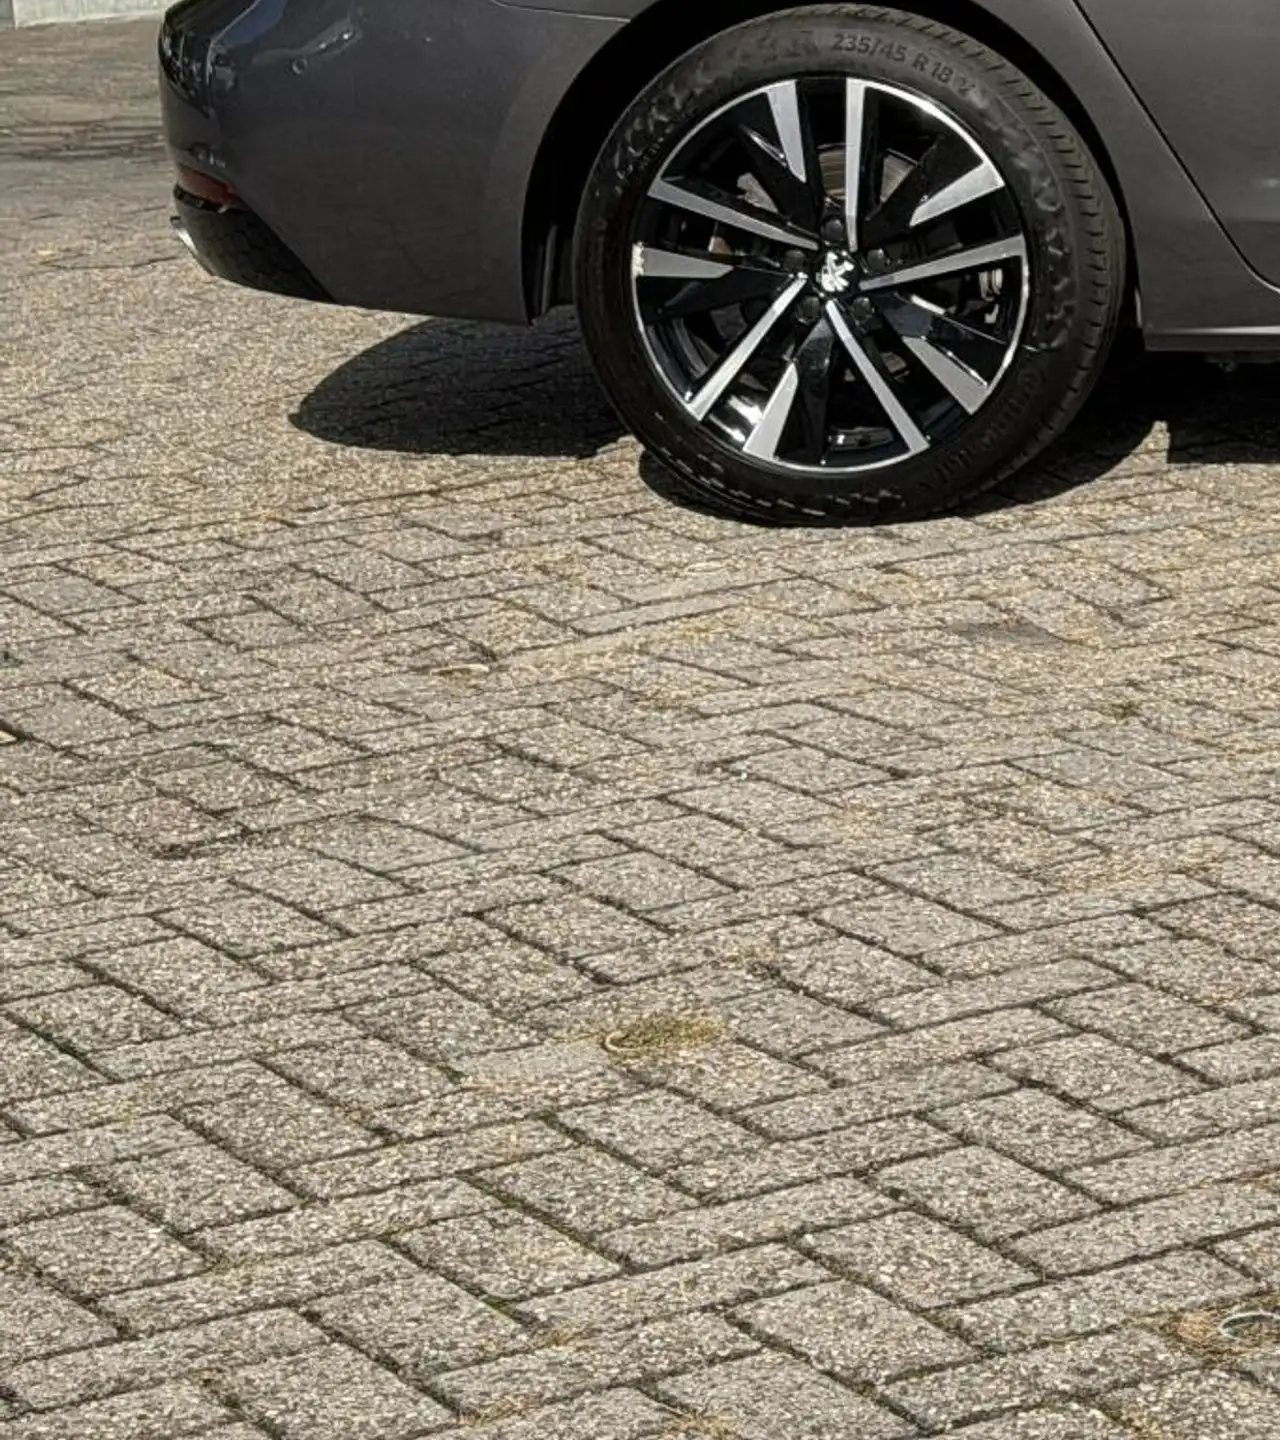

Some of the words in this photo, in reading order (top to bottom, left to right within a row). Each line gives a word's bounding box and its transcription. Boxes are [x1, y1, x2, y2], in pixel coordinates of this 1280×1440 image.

[831, 32, 908, 63] 235/45
[912, 53, 930, 73] R
[931, 61, 955, 83] 18
